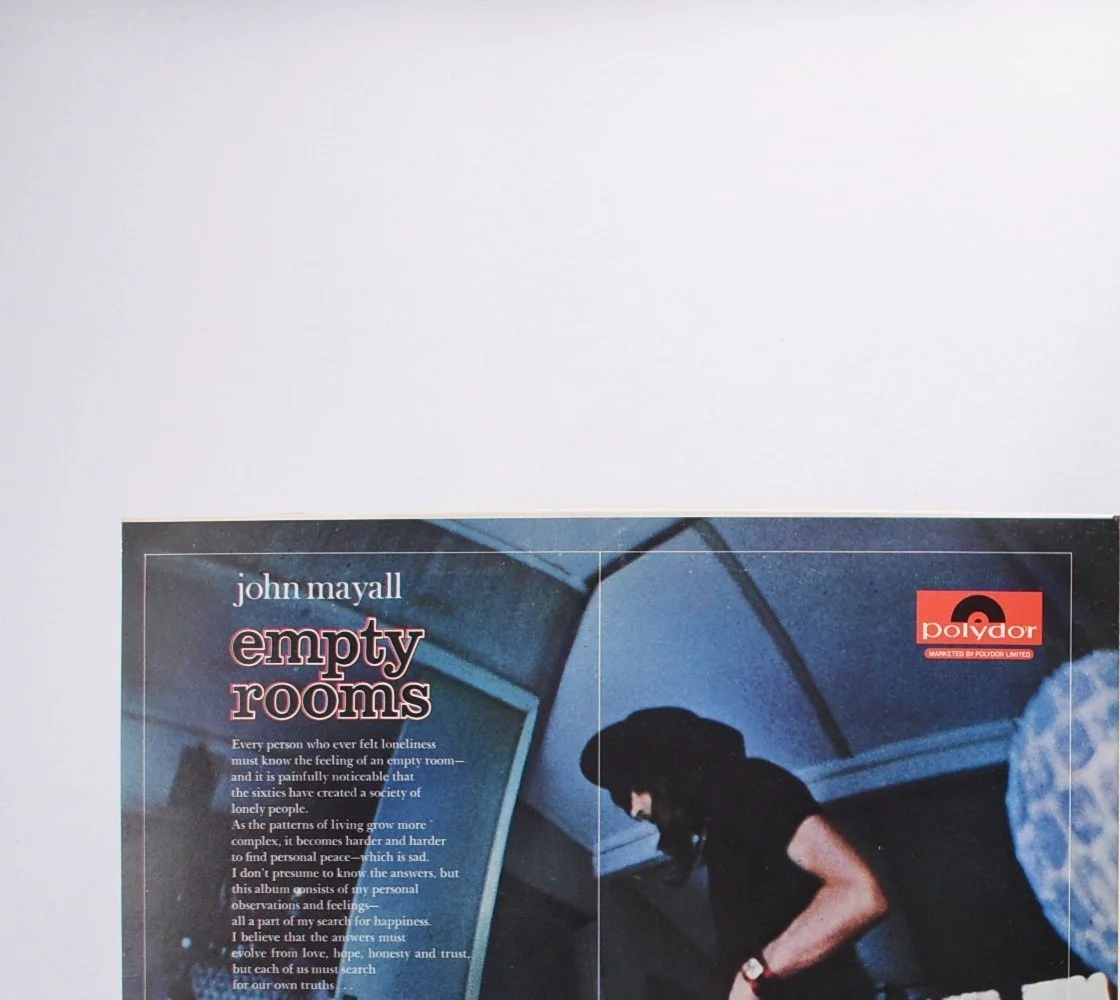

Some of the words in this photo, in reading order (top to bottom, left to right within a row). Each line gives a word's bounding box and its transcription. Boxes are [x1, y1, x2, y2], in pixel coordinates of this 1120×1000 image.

[233, 574, 300, 606] john
[307, 573, 402, 606] mayall
[922, 622, 1037, 640] polydor
[231, 616, 425, 681] empty
[231, 682, 432, 722] rooms
[231, 738, 263, 752] Every
[266, 742, 303, 752] person
[306, 738, 330, 749] who
[359, 738, 378, 749] felt
[380, 738, 436, 749] loneliness
[231, 803, 265, 817] lonely
